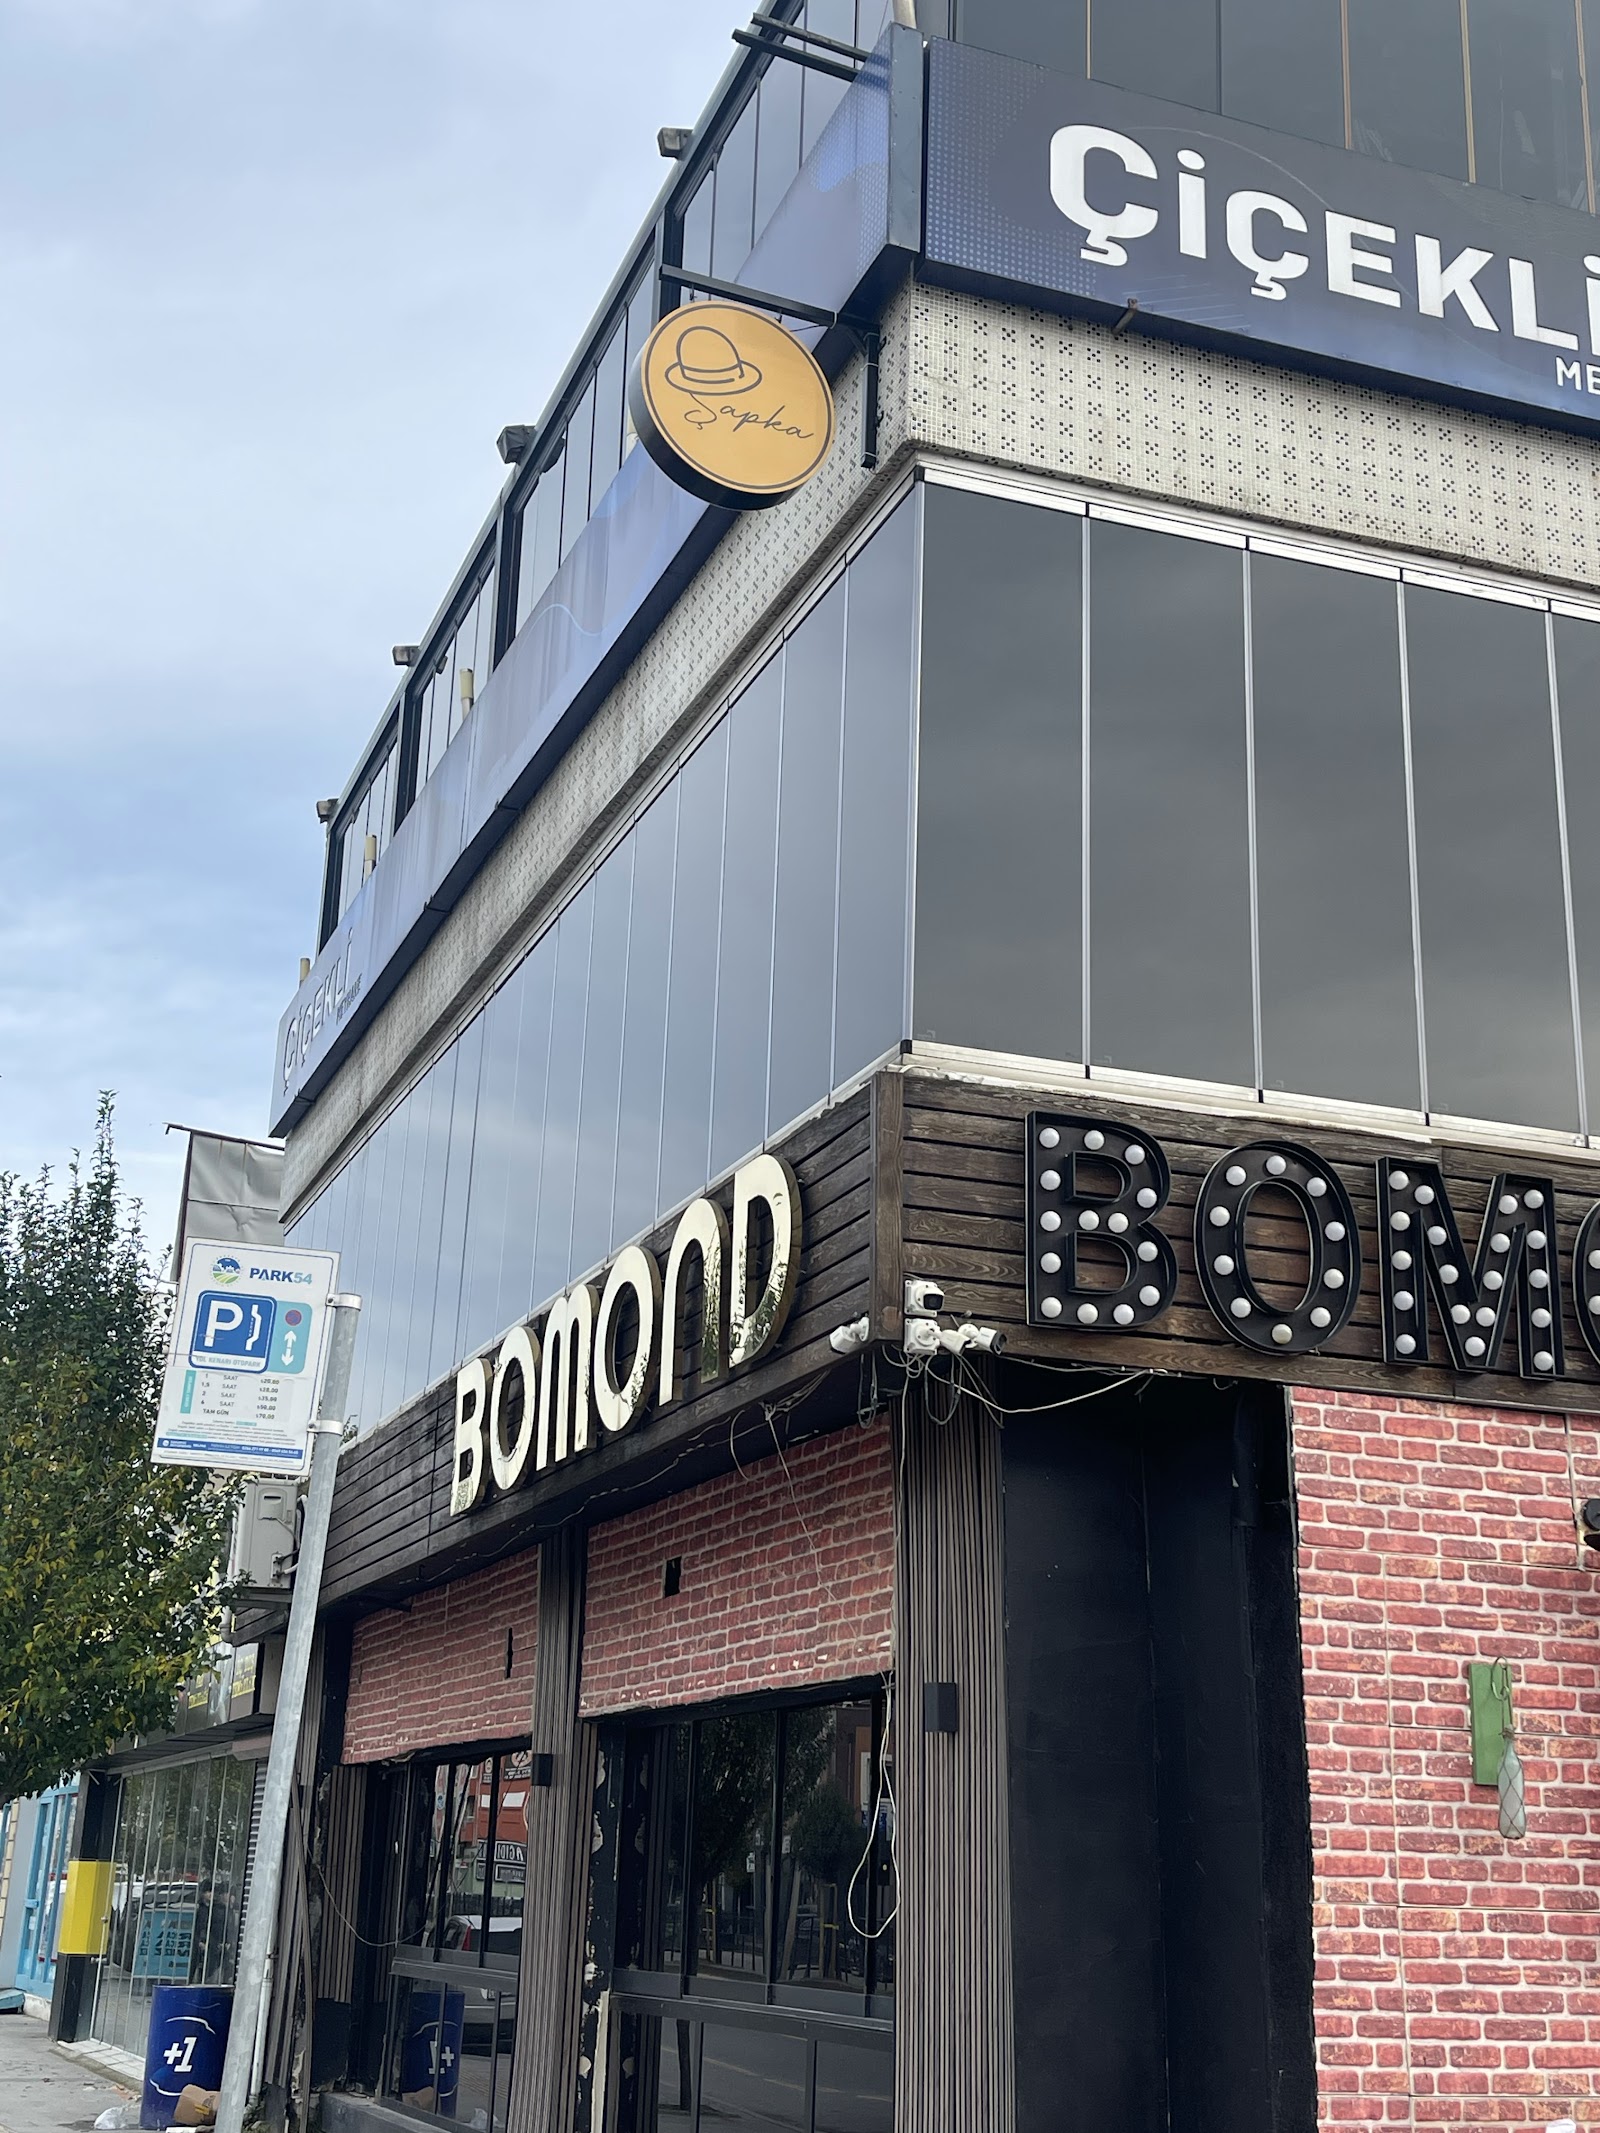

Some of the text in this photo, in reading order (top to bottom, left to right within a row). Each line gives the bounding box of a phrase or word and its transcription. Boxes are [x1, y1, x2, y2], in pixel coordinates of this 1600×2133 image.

[684, 392, 814, 439] Şapka
[1025, 1110, 1600, 1381] BOM
[249, 1267, 312, 1285] PARK54
[204, 1299, 243, 1347] P
[163, 2036, 197, 2073] +1
